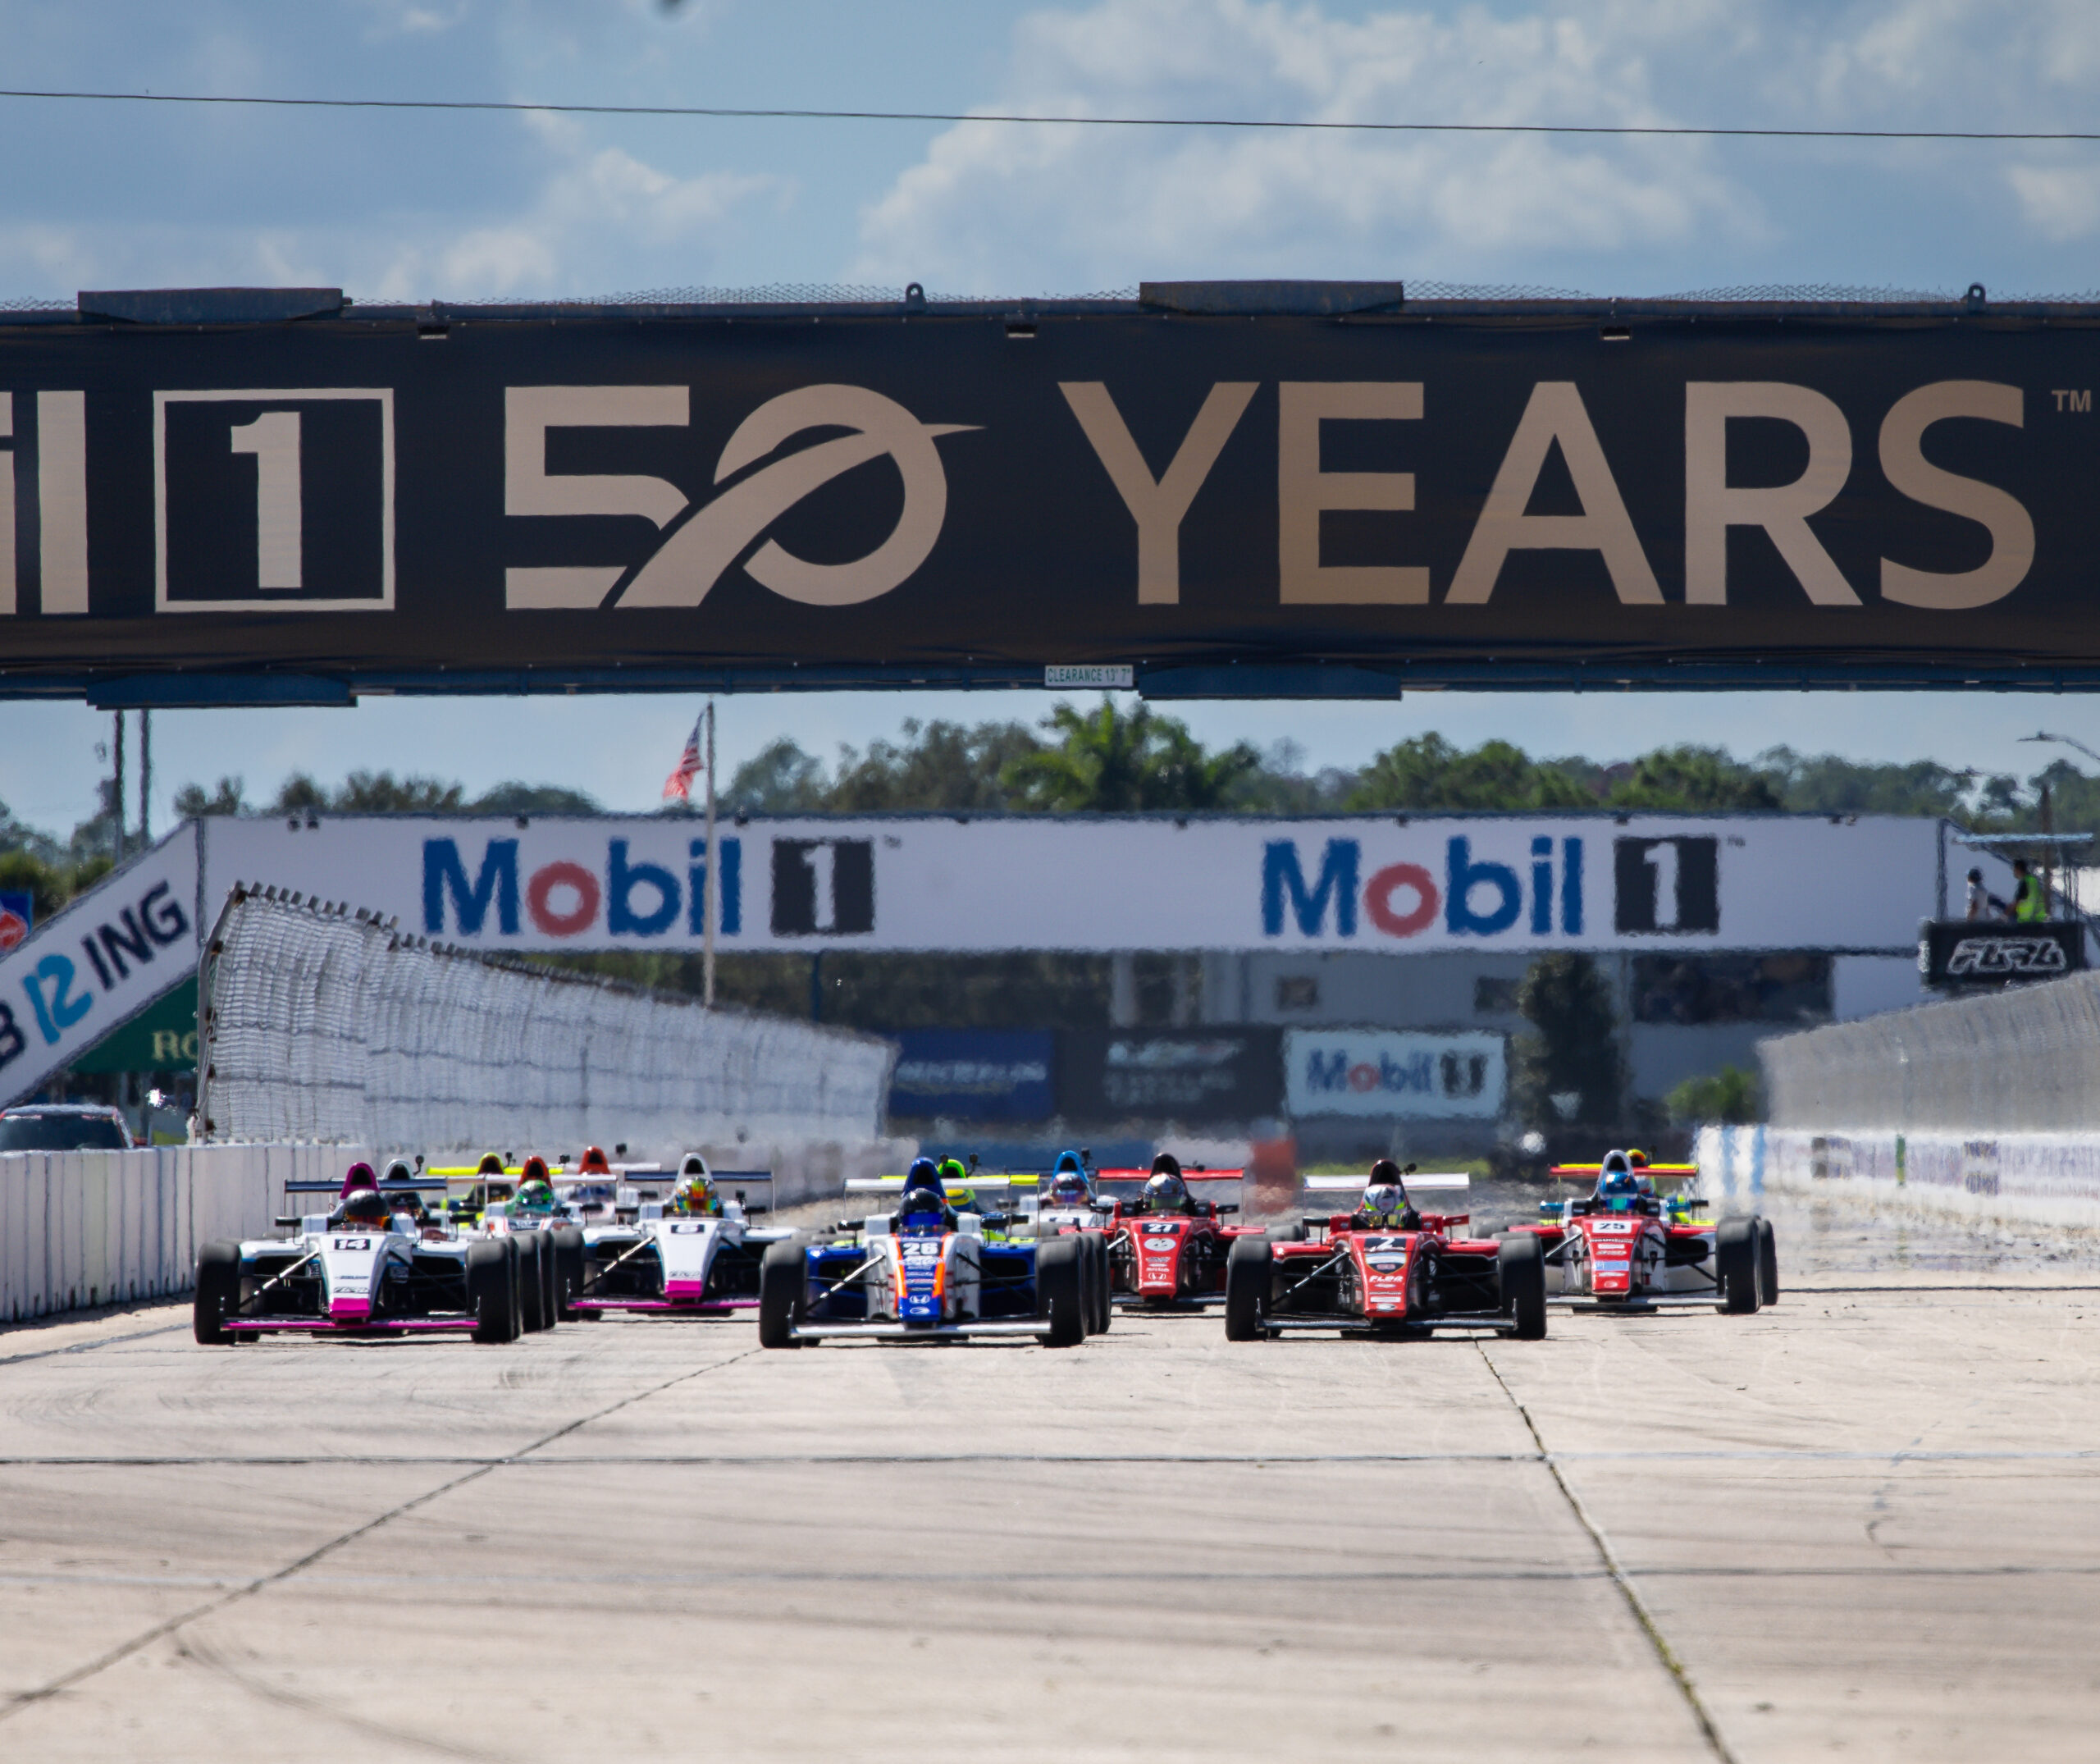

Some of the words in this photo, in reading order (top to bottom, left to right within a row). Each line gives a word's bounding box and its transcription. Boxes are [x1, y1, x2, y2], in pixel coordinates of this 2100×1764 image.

[231, 411, 303, 589] 1
[504, 382, 984, 610] 50
[1057, 379, 2037, 610] YEARS
[2051, 390, 2092, 412] TM
[1048, 667, 1102, 683] CLEARANCE
[422, 835, 742, 937] Mobil
[1261, 834, 1584, 938] Mobil
[1307, 1048, 1435, 1095] Mobil
[338, 1239, 367, 1250] 14
[1148, 1223, 1174, 1233] 27
